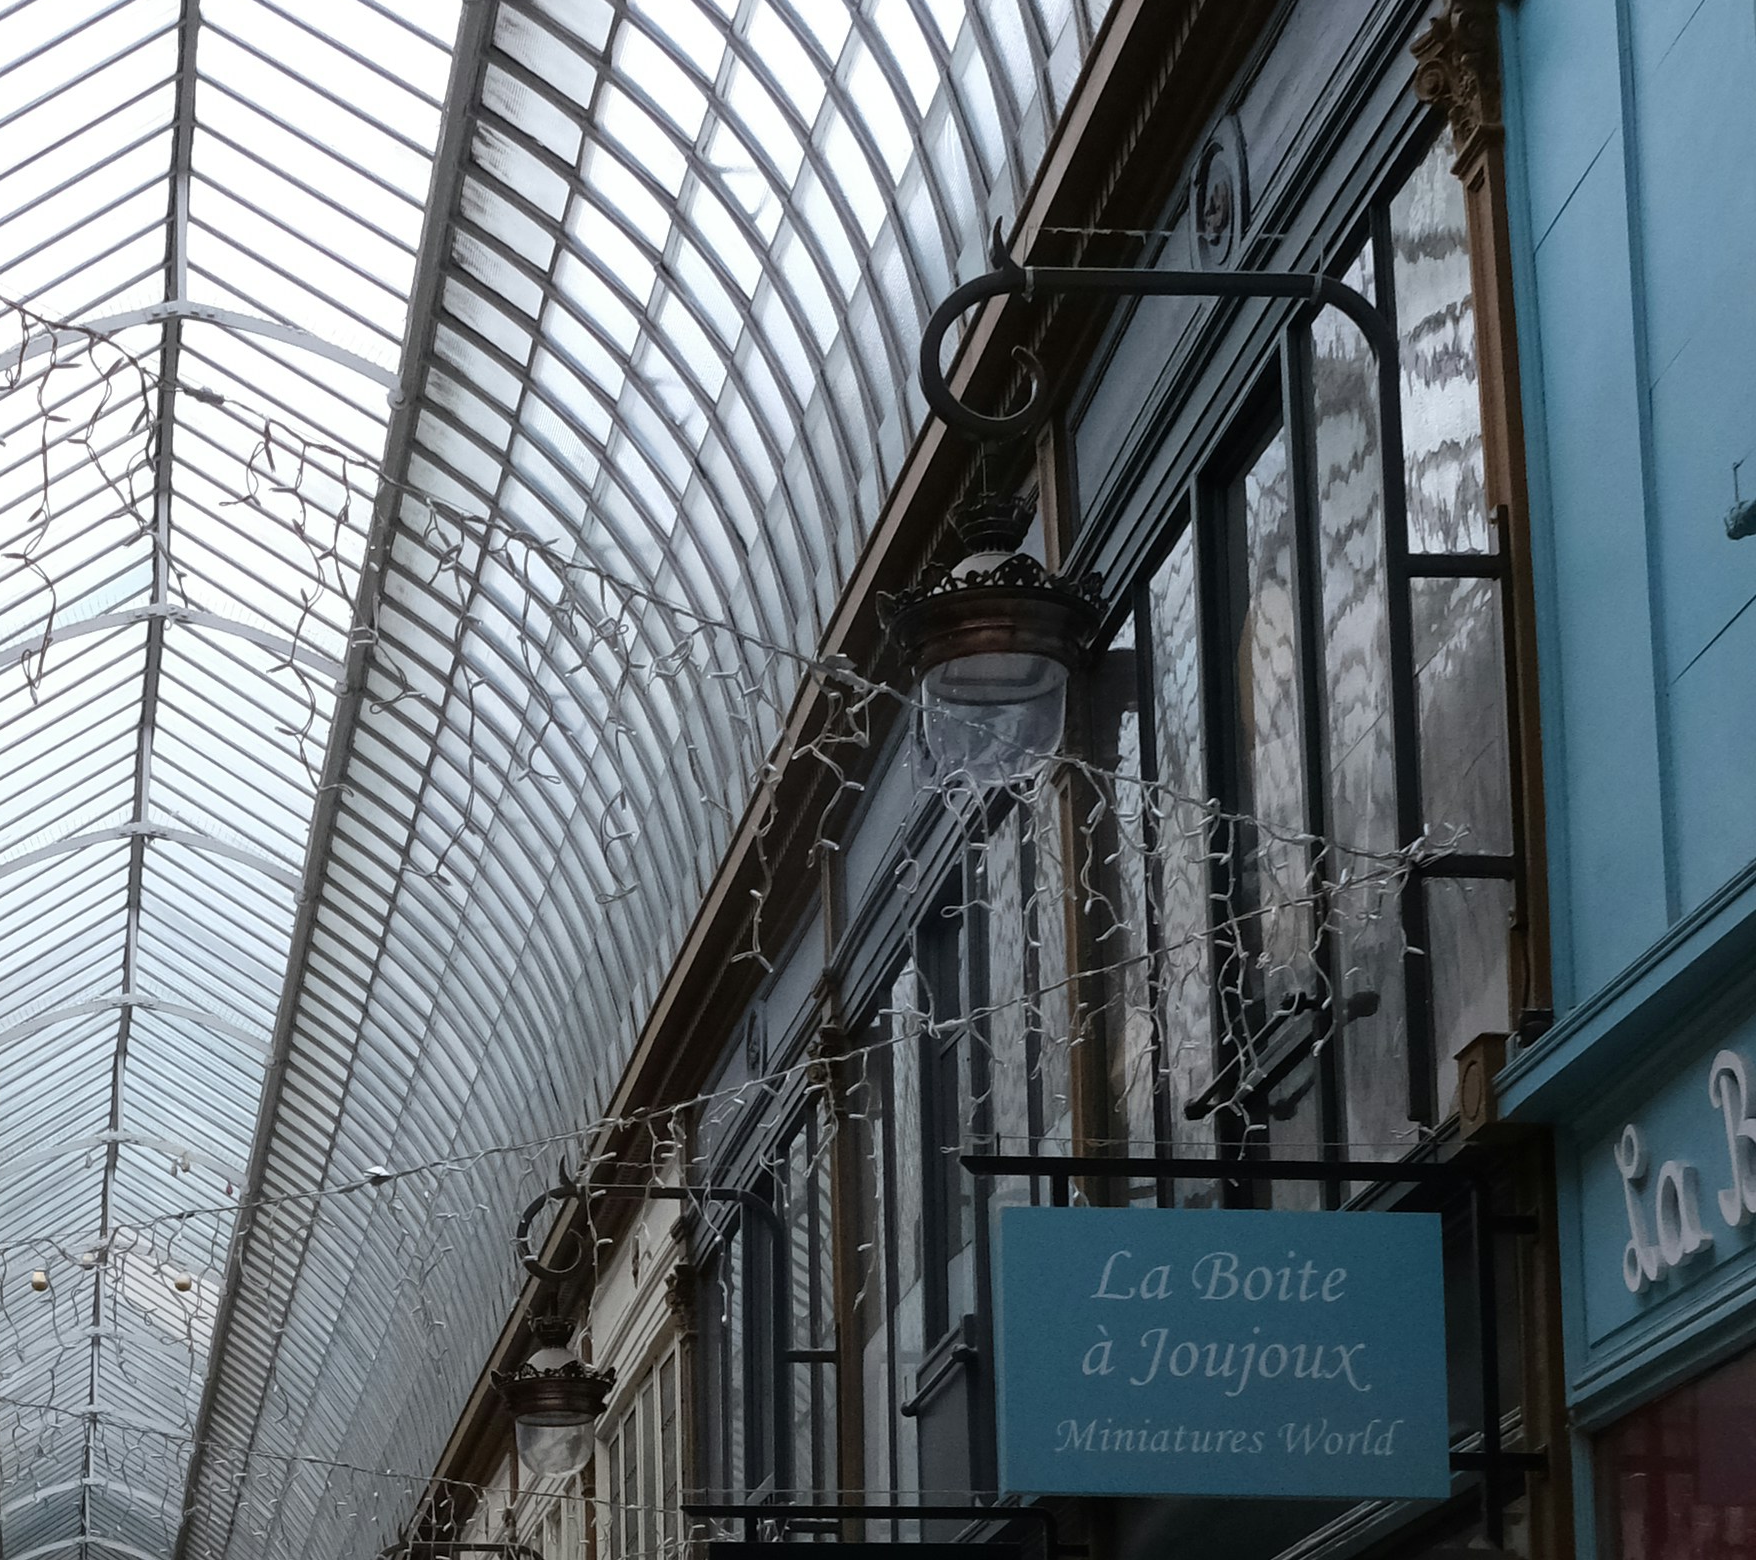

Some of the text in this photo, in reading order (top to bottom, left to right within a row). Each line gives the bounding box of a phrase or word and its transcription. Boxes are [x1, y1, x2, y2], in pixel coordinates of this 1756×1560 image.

[1613, 1123, 1714, 1293] La
[1090, 1250, 1347, 1303] La Boite
[1082, 1324, 1372, 1397] à Joujoux
[1055, 1418, 1404, 1456] Miniatures World
